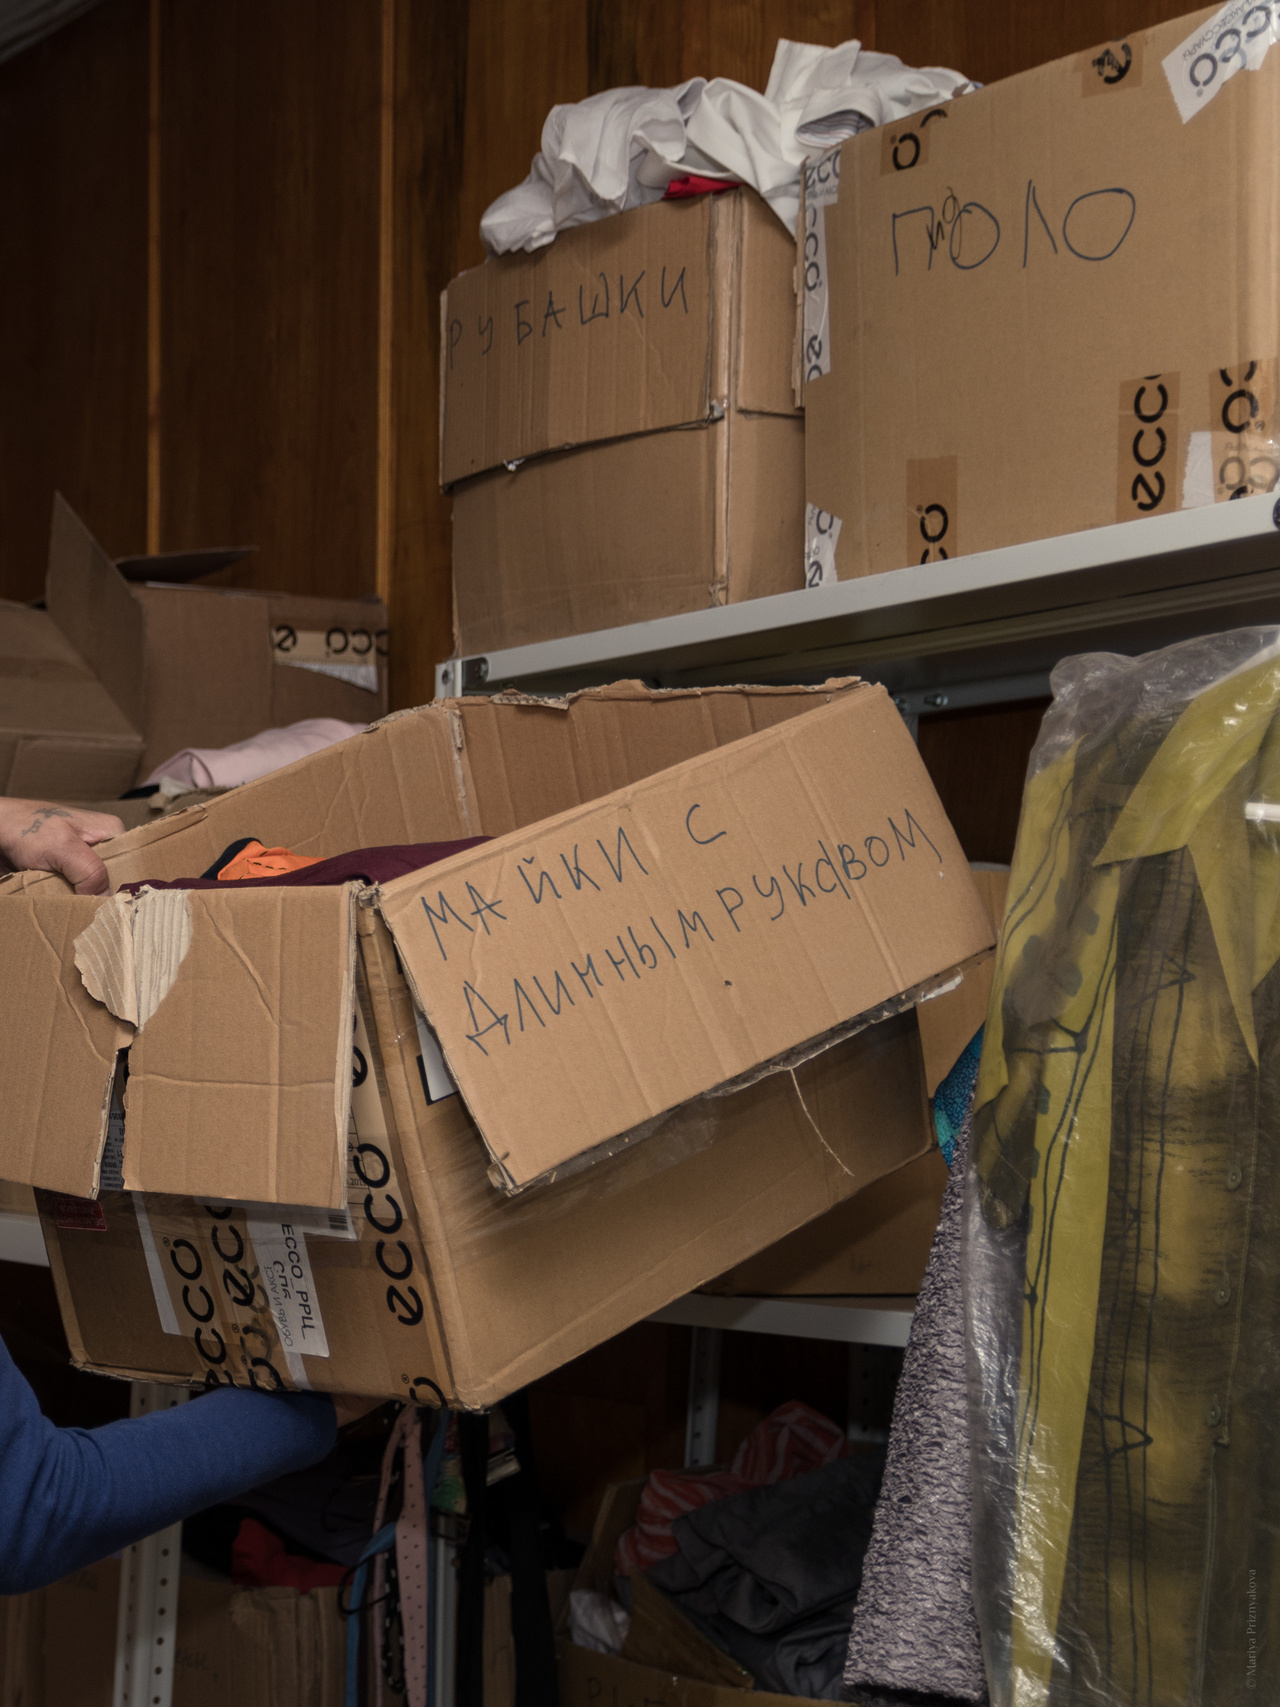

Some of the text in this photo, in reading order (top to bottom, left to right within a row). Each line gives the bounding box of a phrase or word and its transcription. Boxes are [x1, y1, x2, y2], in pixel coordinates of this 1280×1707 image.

[449, 266, 688, 370] РУБАШКИ
[420, 803, 727, 960] МАЙКИ С
[463, 909, 715, 1056] ДЛИННЫМ
